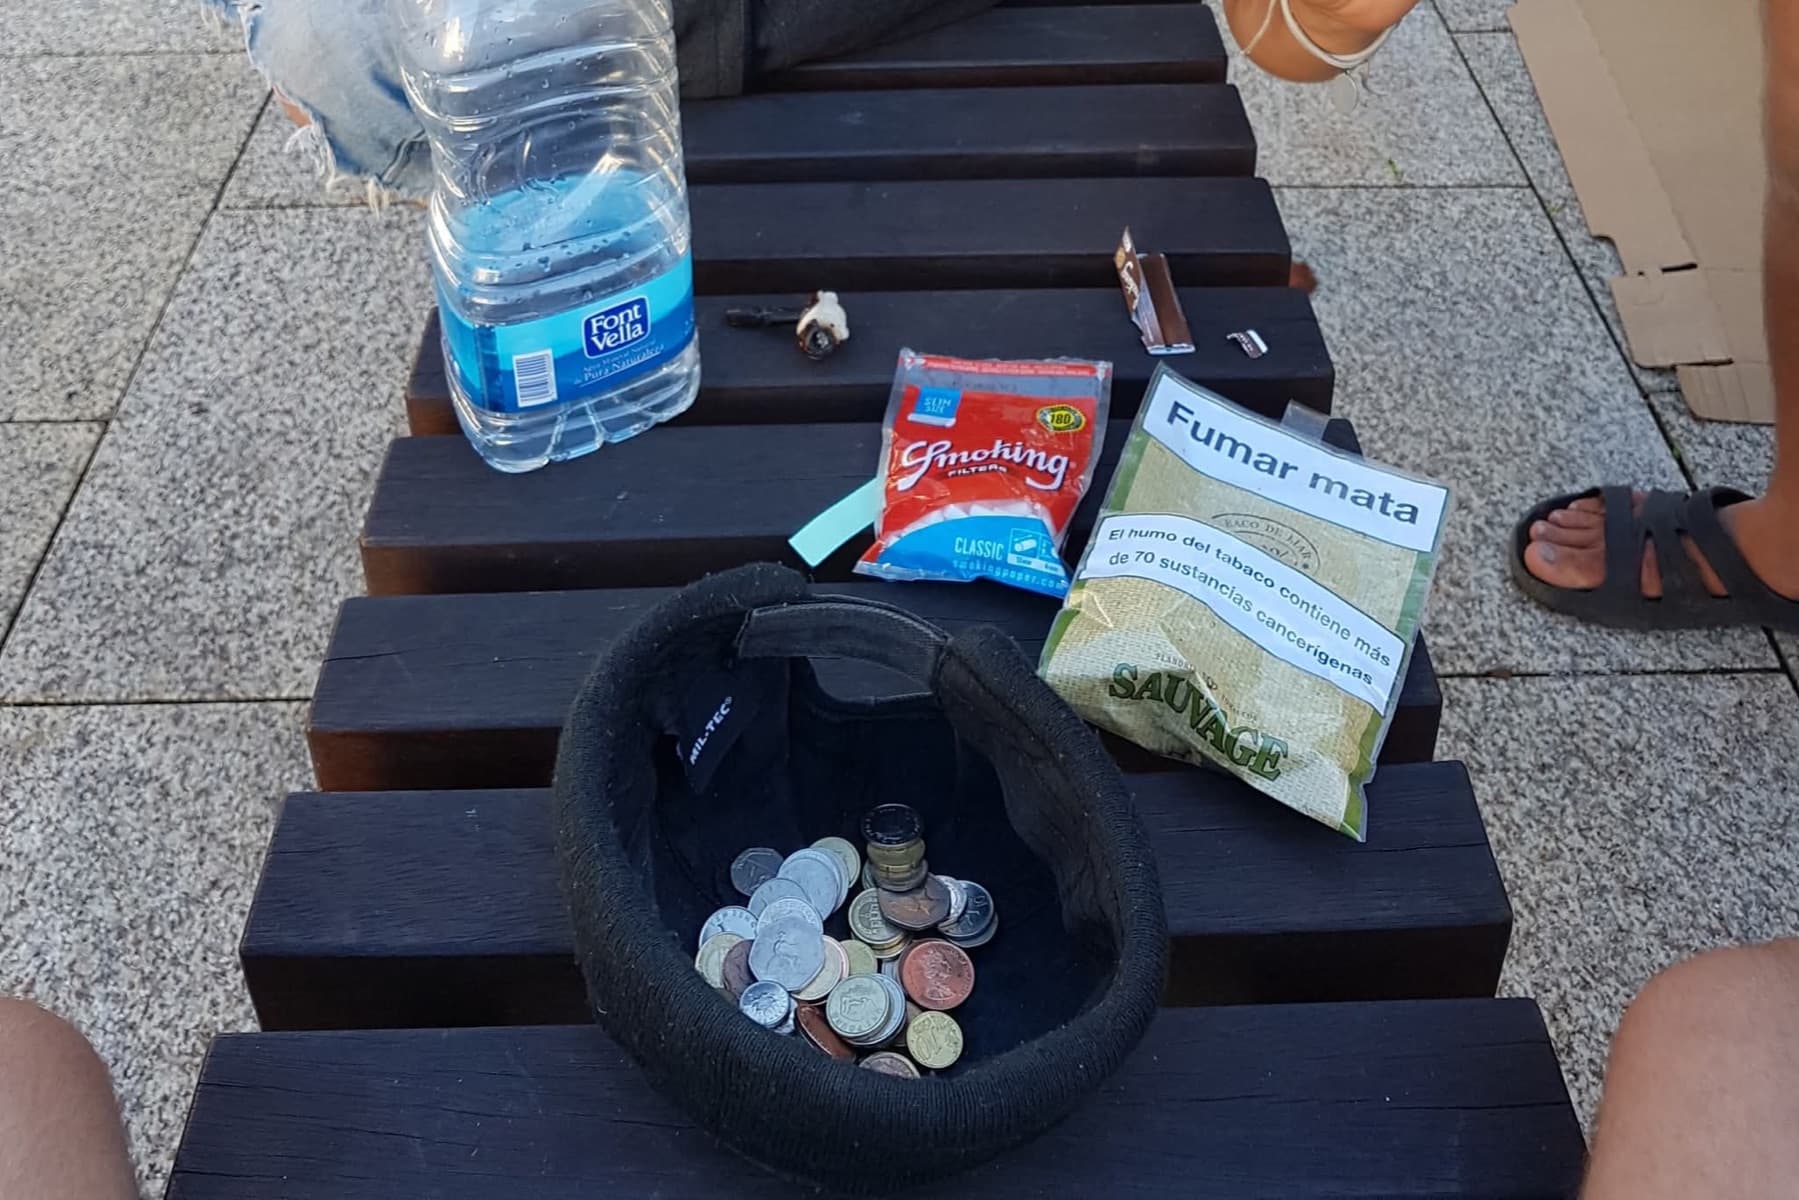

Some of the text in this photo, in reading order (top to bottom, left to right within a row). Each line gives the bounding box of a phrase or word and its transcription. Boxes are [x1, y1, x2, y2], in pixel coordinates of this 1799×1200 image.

[590, 322, 645, 351] Vella
[591, 304, 642, 335] Font
[1050, 413, 1072, 426] 180
[897, 440, 1069, 491] Smoking
[1165, 400, 1419, 526] Fumar mata
[954, 537, 1004, 561] CLASSIC
[1108, 529, 1125, 541] El
[1127, 529, 1178, 542] humo
[1182, 536, 1211, 554] del
[1215, 548, 1275, 588] tabaco
[1279, 586, 1352, 640] contiene
[1353, 636, 1391, 667] más
[1109, 551, 1373, 685] de 70 sustancias cancerígenas
[690, 703, 730, 765] MIL-TEC
[1109, 662, 1289, 782] SAUVAGE
